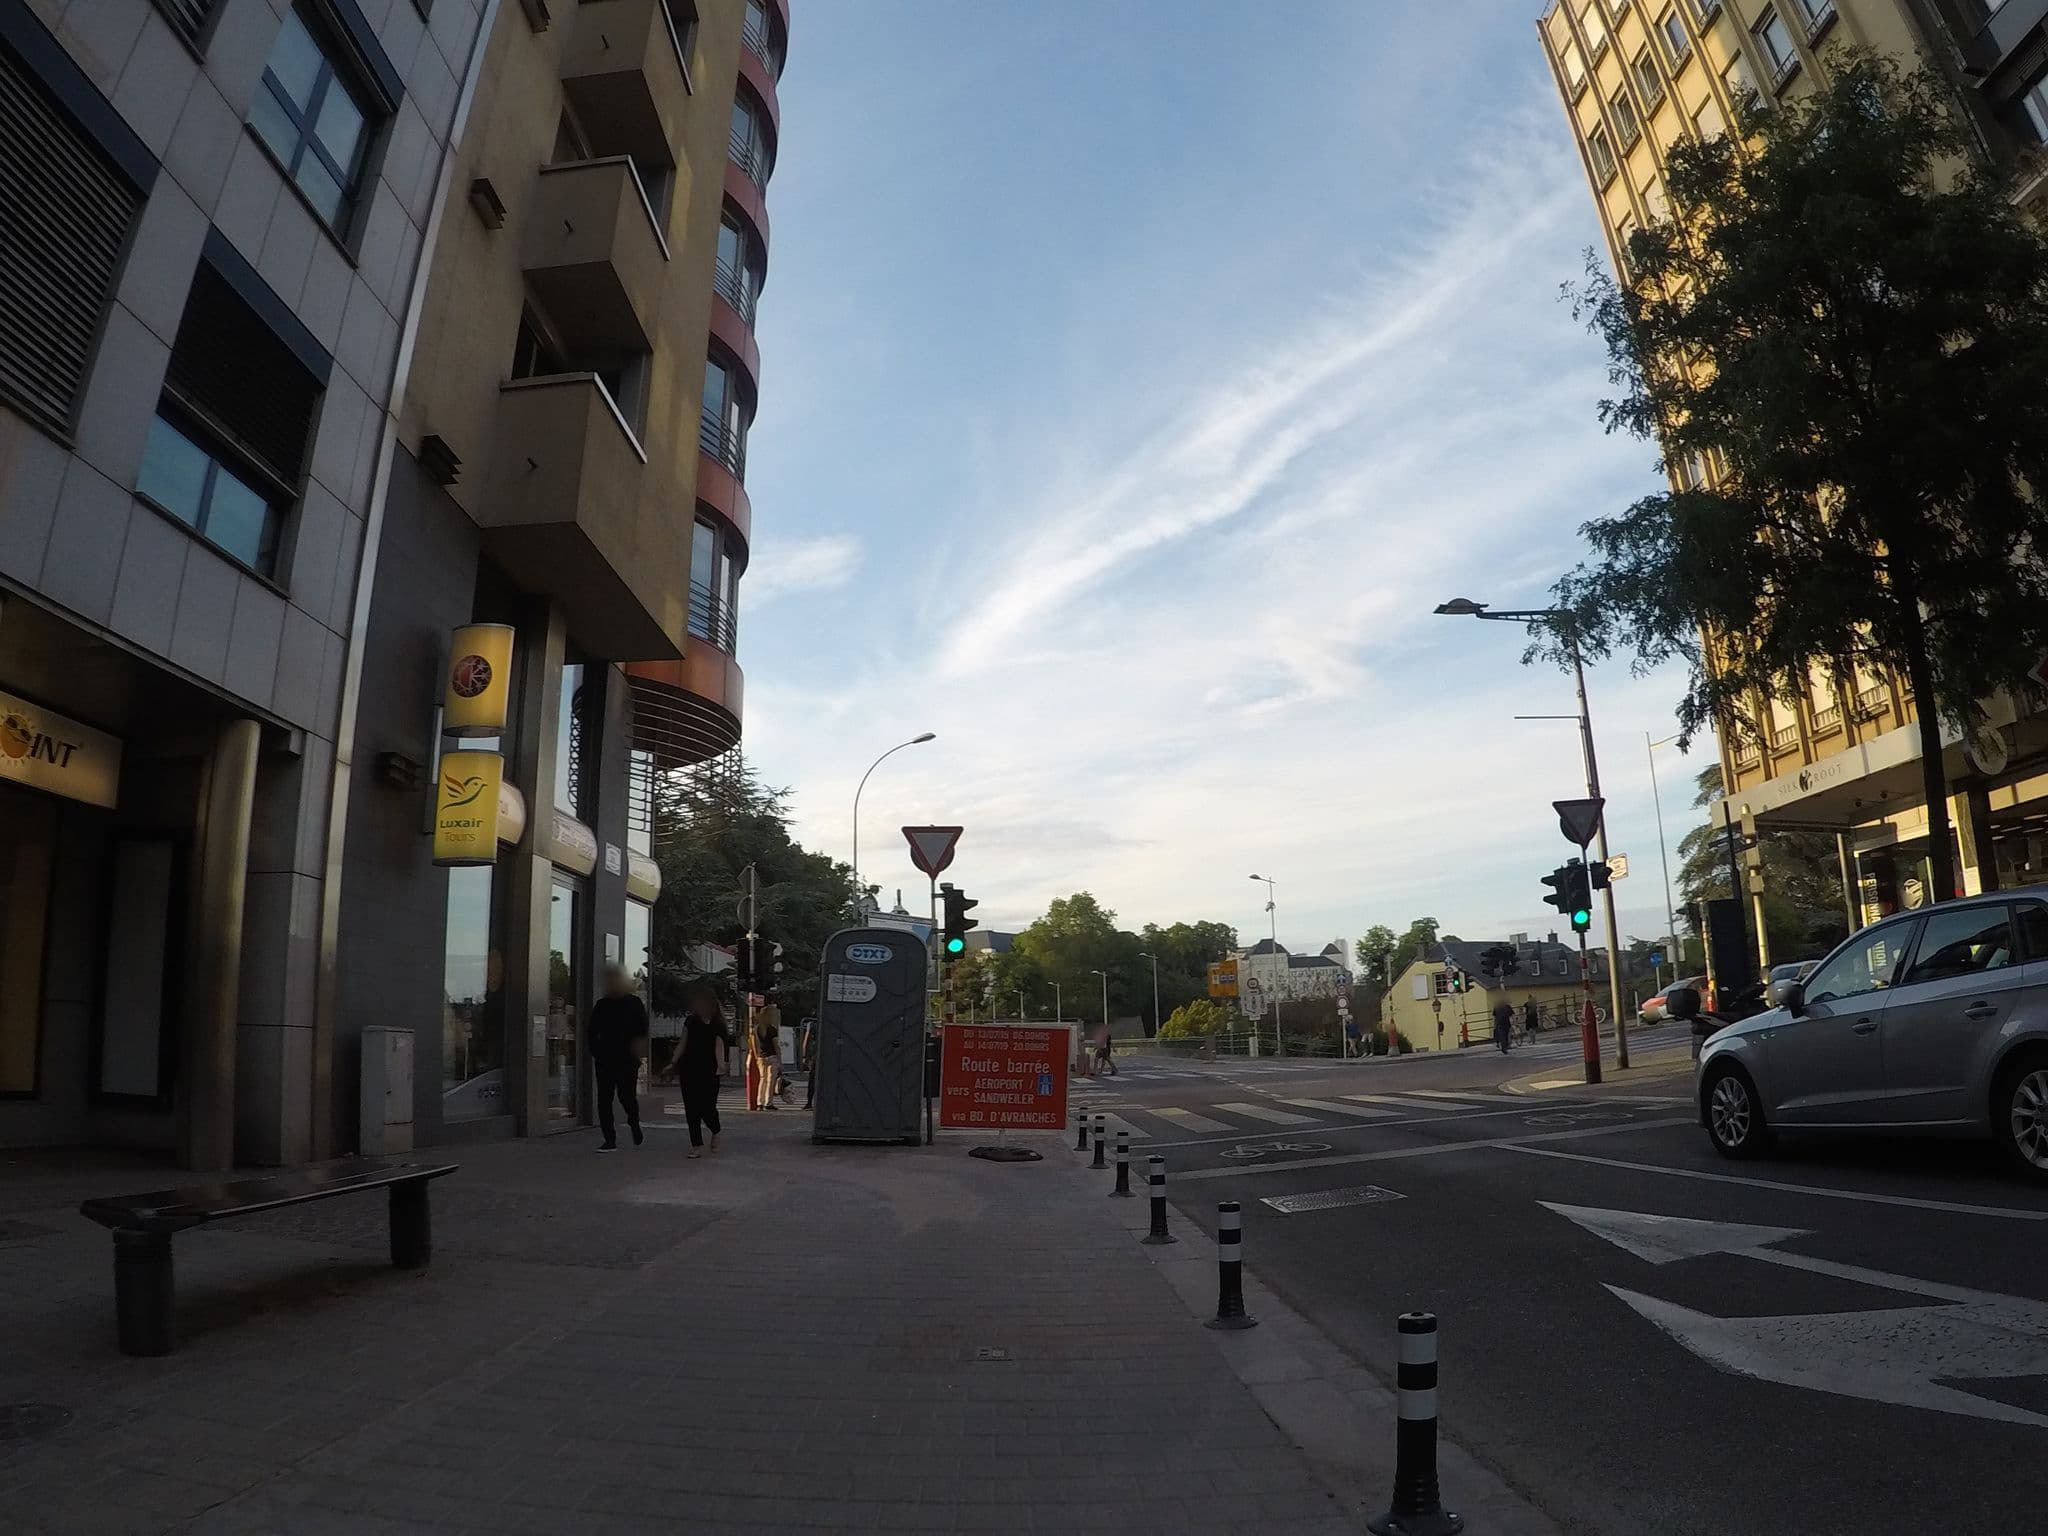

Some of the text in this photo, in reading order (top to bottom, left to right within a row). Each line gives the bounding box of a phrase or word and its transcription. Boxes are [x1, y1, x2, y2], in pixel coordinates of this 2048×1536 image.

[440, 817, 485, 829] Luxair
[444, 831, 476, 842] Tours
[961, 1056, 1050, 1073] Route barrée
[974, 1078, 1024, 1090] AEROPORT
[947, 1086, 970, 1096] vers
[973, 1092, 1035, 1105] SANDWEILER
[951, 1110, 1057, 1124] via BD. D'AVRANCHES
